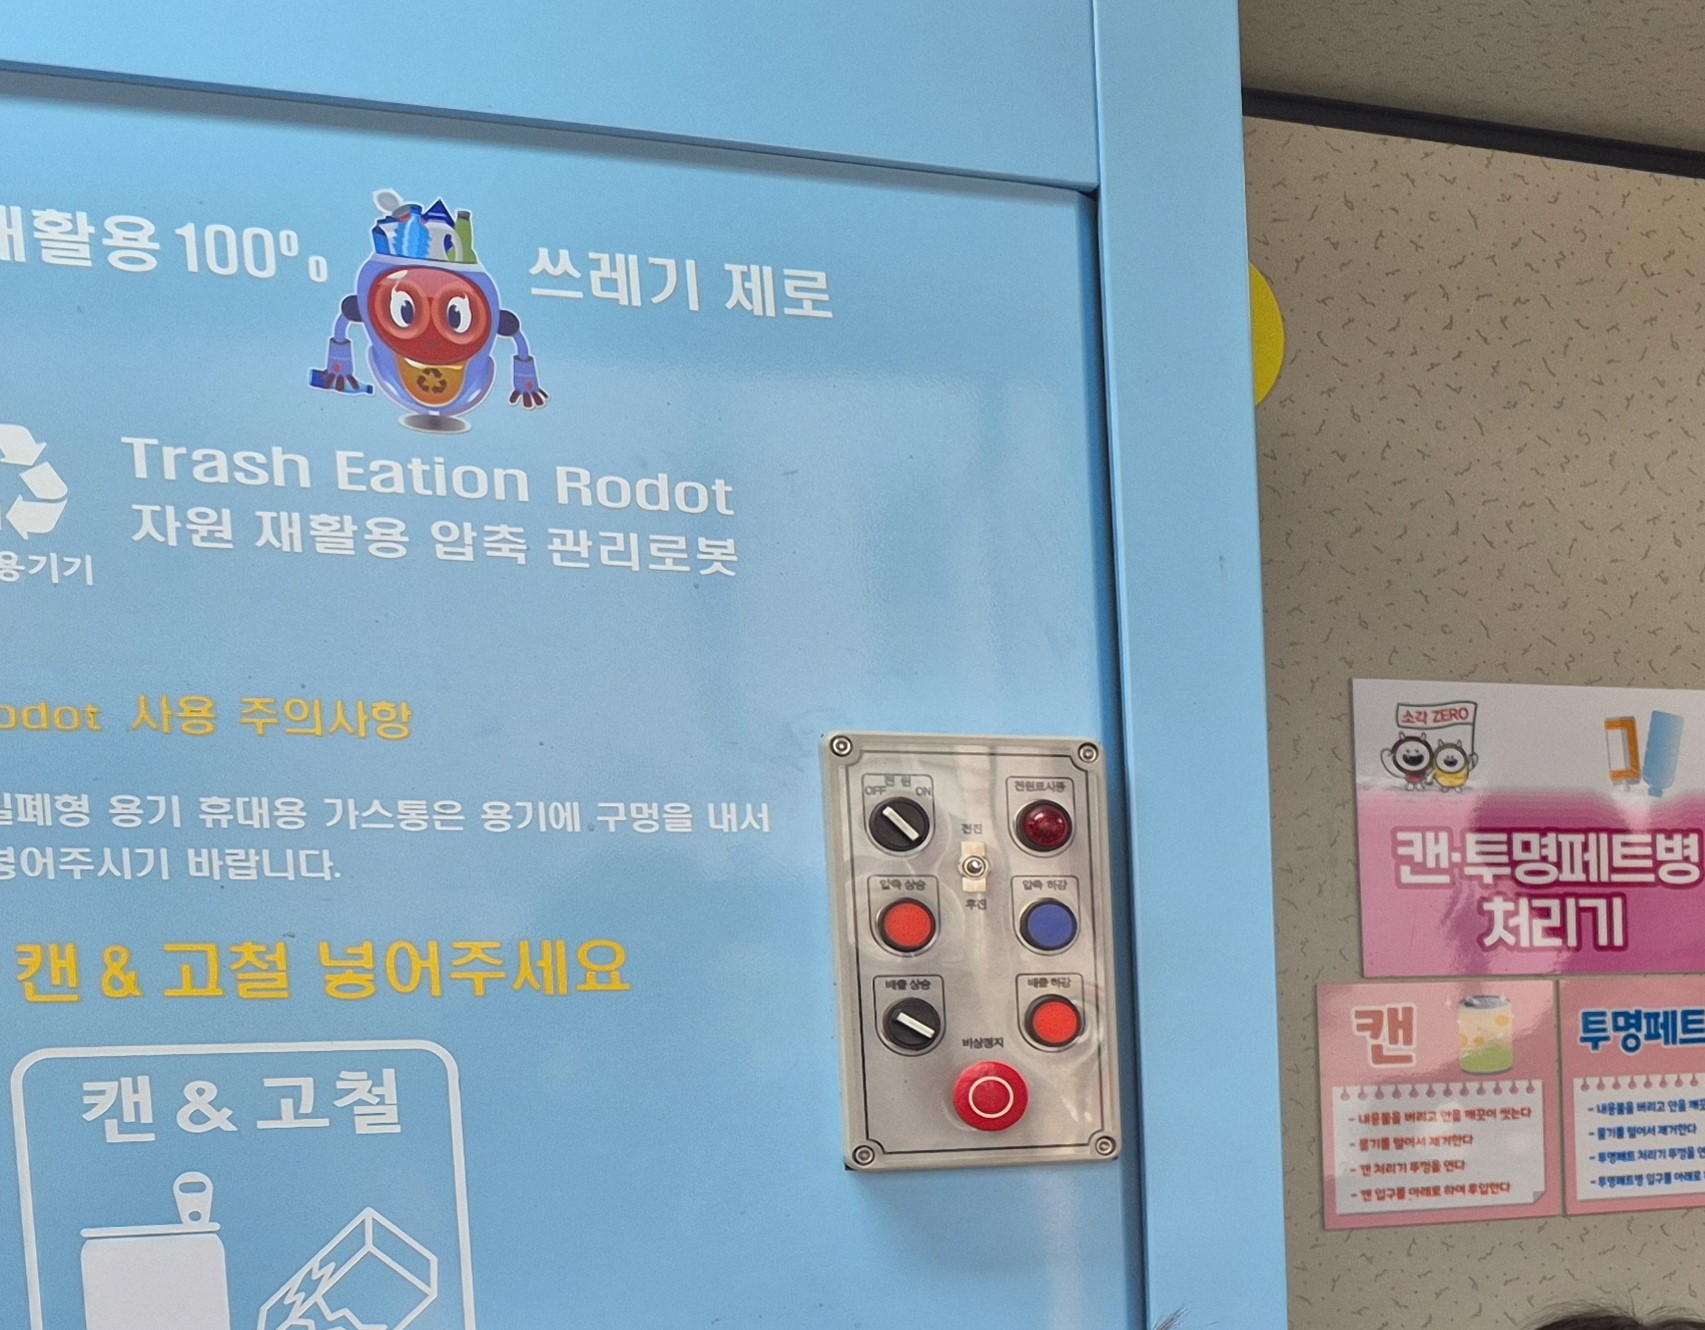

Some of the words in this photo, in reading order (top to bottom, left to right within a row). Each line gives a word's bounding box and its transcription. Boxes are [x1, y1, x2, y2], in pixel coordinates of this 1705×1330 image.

[528, 246, 701, 312] 쓰레기
[724, 262, 834, 320] 제로
[121, 436, 311, 488] Trash
[335, 450, 530, 502] Eation
[555, 465, 735, 516] Rodot
[131, 503, 234, 549] 자원
[255, 510, 410, 559] 재활용
[430, 520, 528, 565] 압축
[548, 527, 738, 576] 관리로봇
[130, 694, 217, 735] 사용
[239, 696, 412, 740] 주의사항
[1402, 709, 1428, 725] 소각
[1431, 707, 1469, 723] ZERO
[864, 785, 886, 796] OFF
[915, 786, 931, 796] ON
[108, 794, 182, 829] 용기
[199, 795, 307, 831] 휴대용
[323, 797, 465, 832] 가스통은
[481, 799, 582, 833] 용기에
[597, 801, 694, 833] 구멍을
[708, 801, 771, 833] 내서
[188, 846, 341, 881] 바랍니다.
[1482, 896, 1624, 948] 처리기
[14, 941, 82, 1002] 캔
[99, 943, 144, 998] &
[162, 940, 291, 1000] 고철
[318, 939, 632, 1001] 넣어주세요
[963, 1037, 1004, 1049] 비상정지
[1354, 1006, 1414, 1065] 캔
[81, 1074, 155, 1143] 캔
[175, 1079, 239, 1134] &
[256, 1068, 402, 1134] 고철
[1637, 1101, 1665, 1113] 버리고
[1404, 1110, 1438, 1123] 버리고
[1657, 1123, 1697, 1136] 제거한다
[1428, 1134, 1473, 1147] 제거한다
[1598, 1150, 1635, 1164] 투명페트
[1637, 1148, 1666, 1160] 처리기
[1374, 1161, 1407, 1175] 처리기
[1443, 1159, 1465, 1172] 연다
[1468, 1182, 1511, 1196] 투입한다
